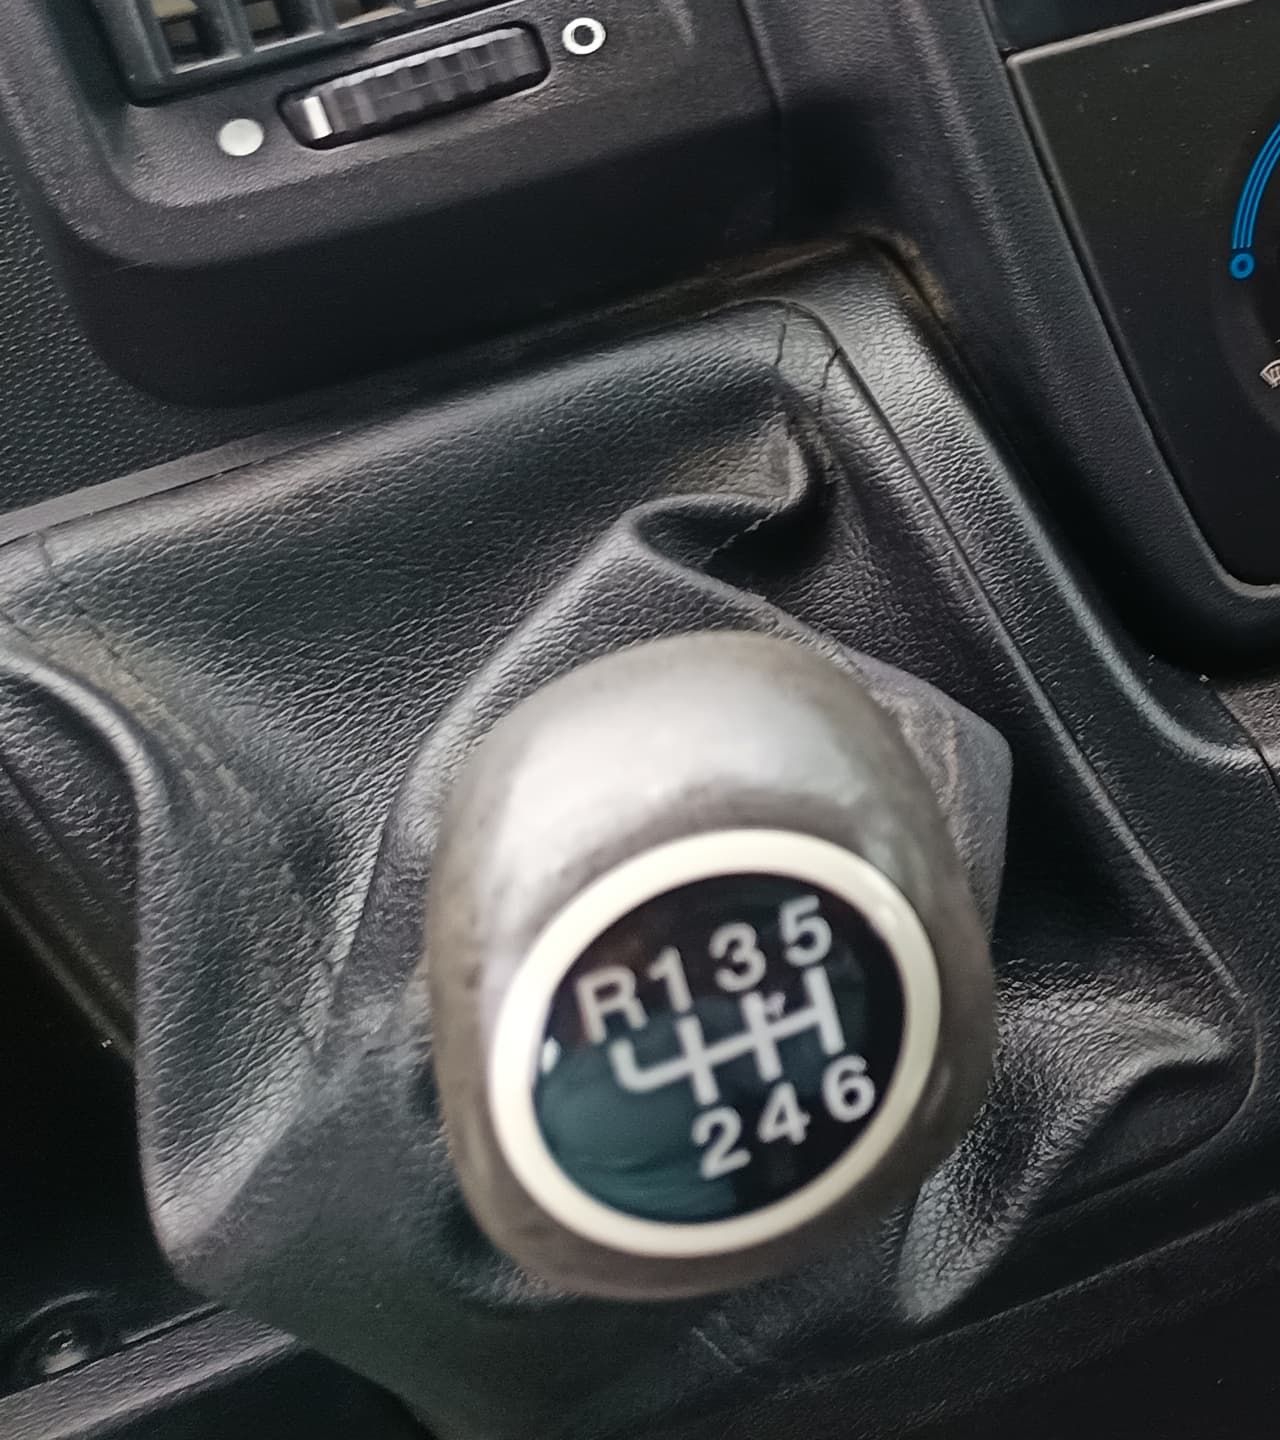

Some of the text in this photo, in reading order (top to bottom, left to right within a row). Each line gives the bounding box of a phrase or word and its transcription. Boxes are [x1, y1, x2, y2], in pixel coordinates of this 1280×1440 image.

[573, 894, 834, 1044] R 1 3 5
[691, 1054, 877, 1180] 2 4 6
